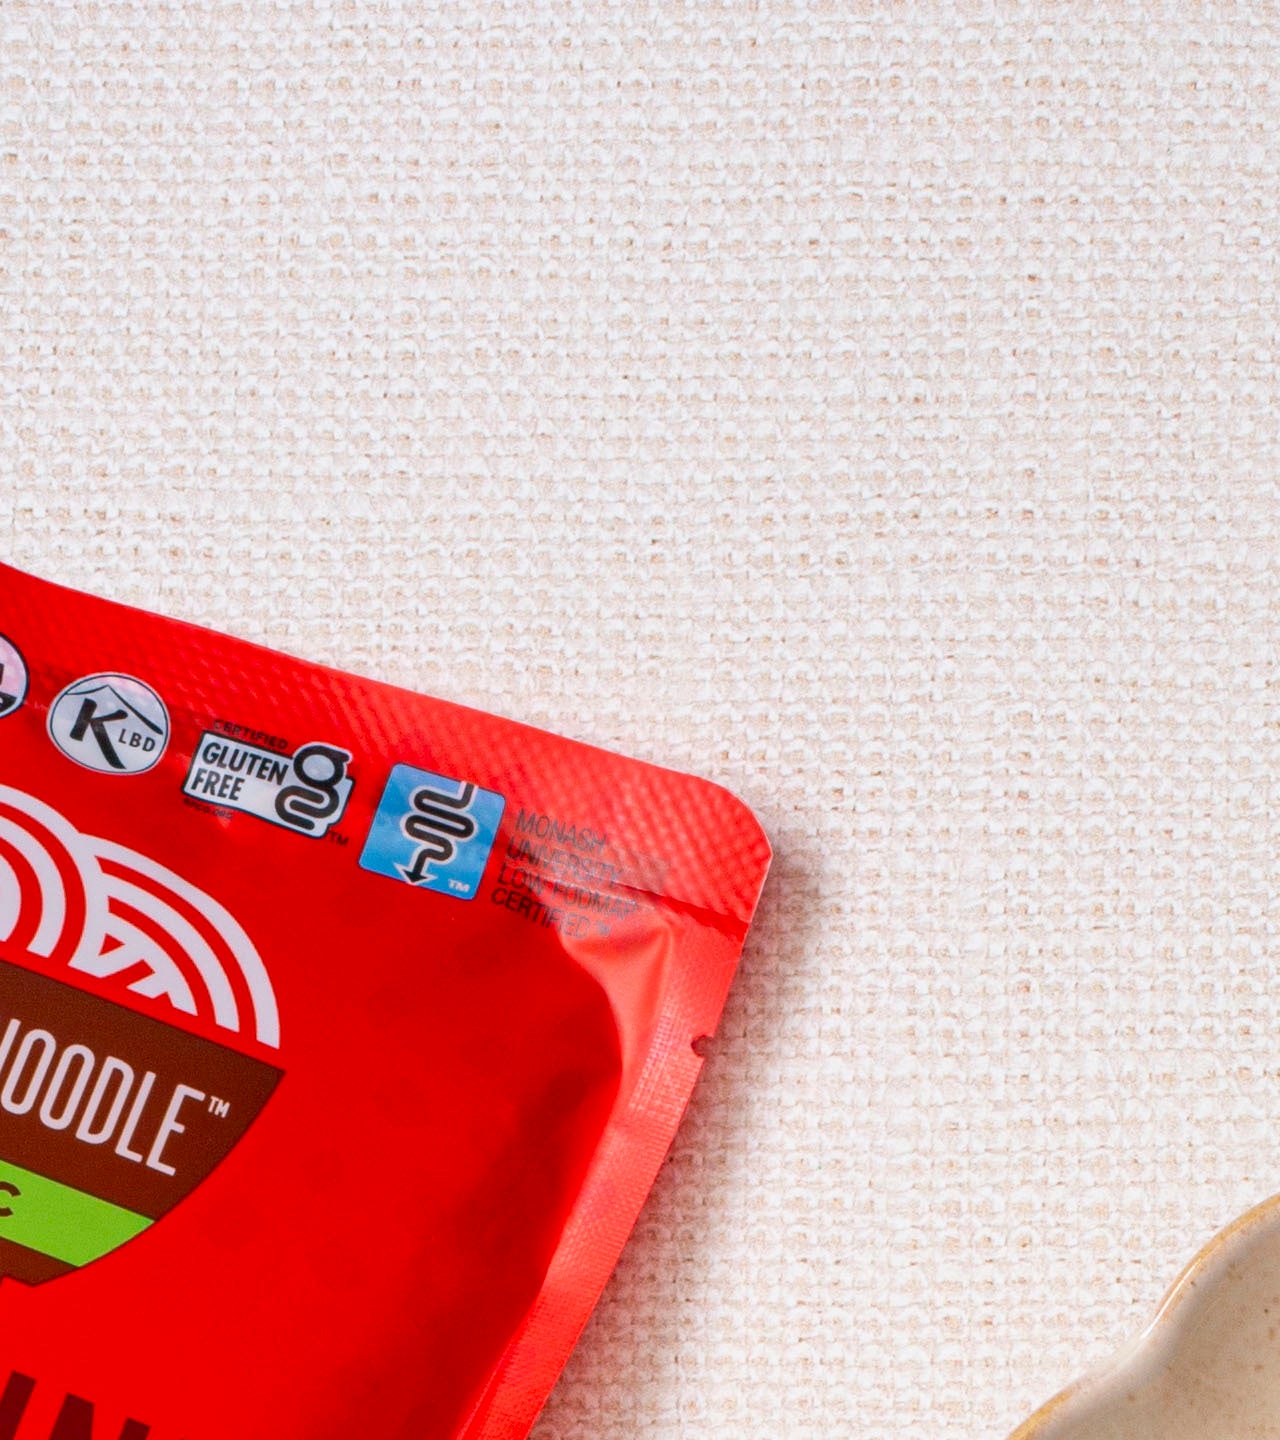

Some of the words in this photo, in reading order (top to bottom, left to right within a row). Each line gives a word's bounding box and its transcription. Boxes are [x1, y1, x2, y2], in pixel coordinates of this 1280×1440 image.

[118, 728, 156, 752] LBD
[213, 719, 289, 750] CERTIFIED
[191, 767, 245, 801] FREE
[202, 742, 289, 785] GLUTEN
[514, 809, 607, 856] MONASH
[505, 835, 625, 888] UNIVERSITY
[490, 887, 590, 939] CERTIFIED
[496, 862, 546, 898] LOW
[551, 879, 640, 920] FODMAP
